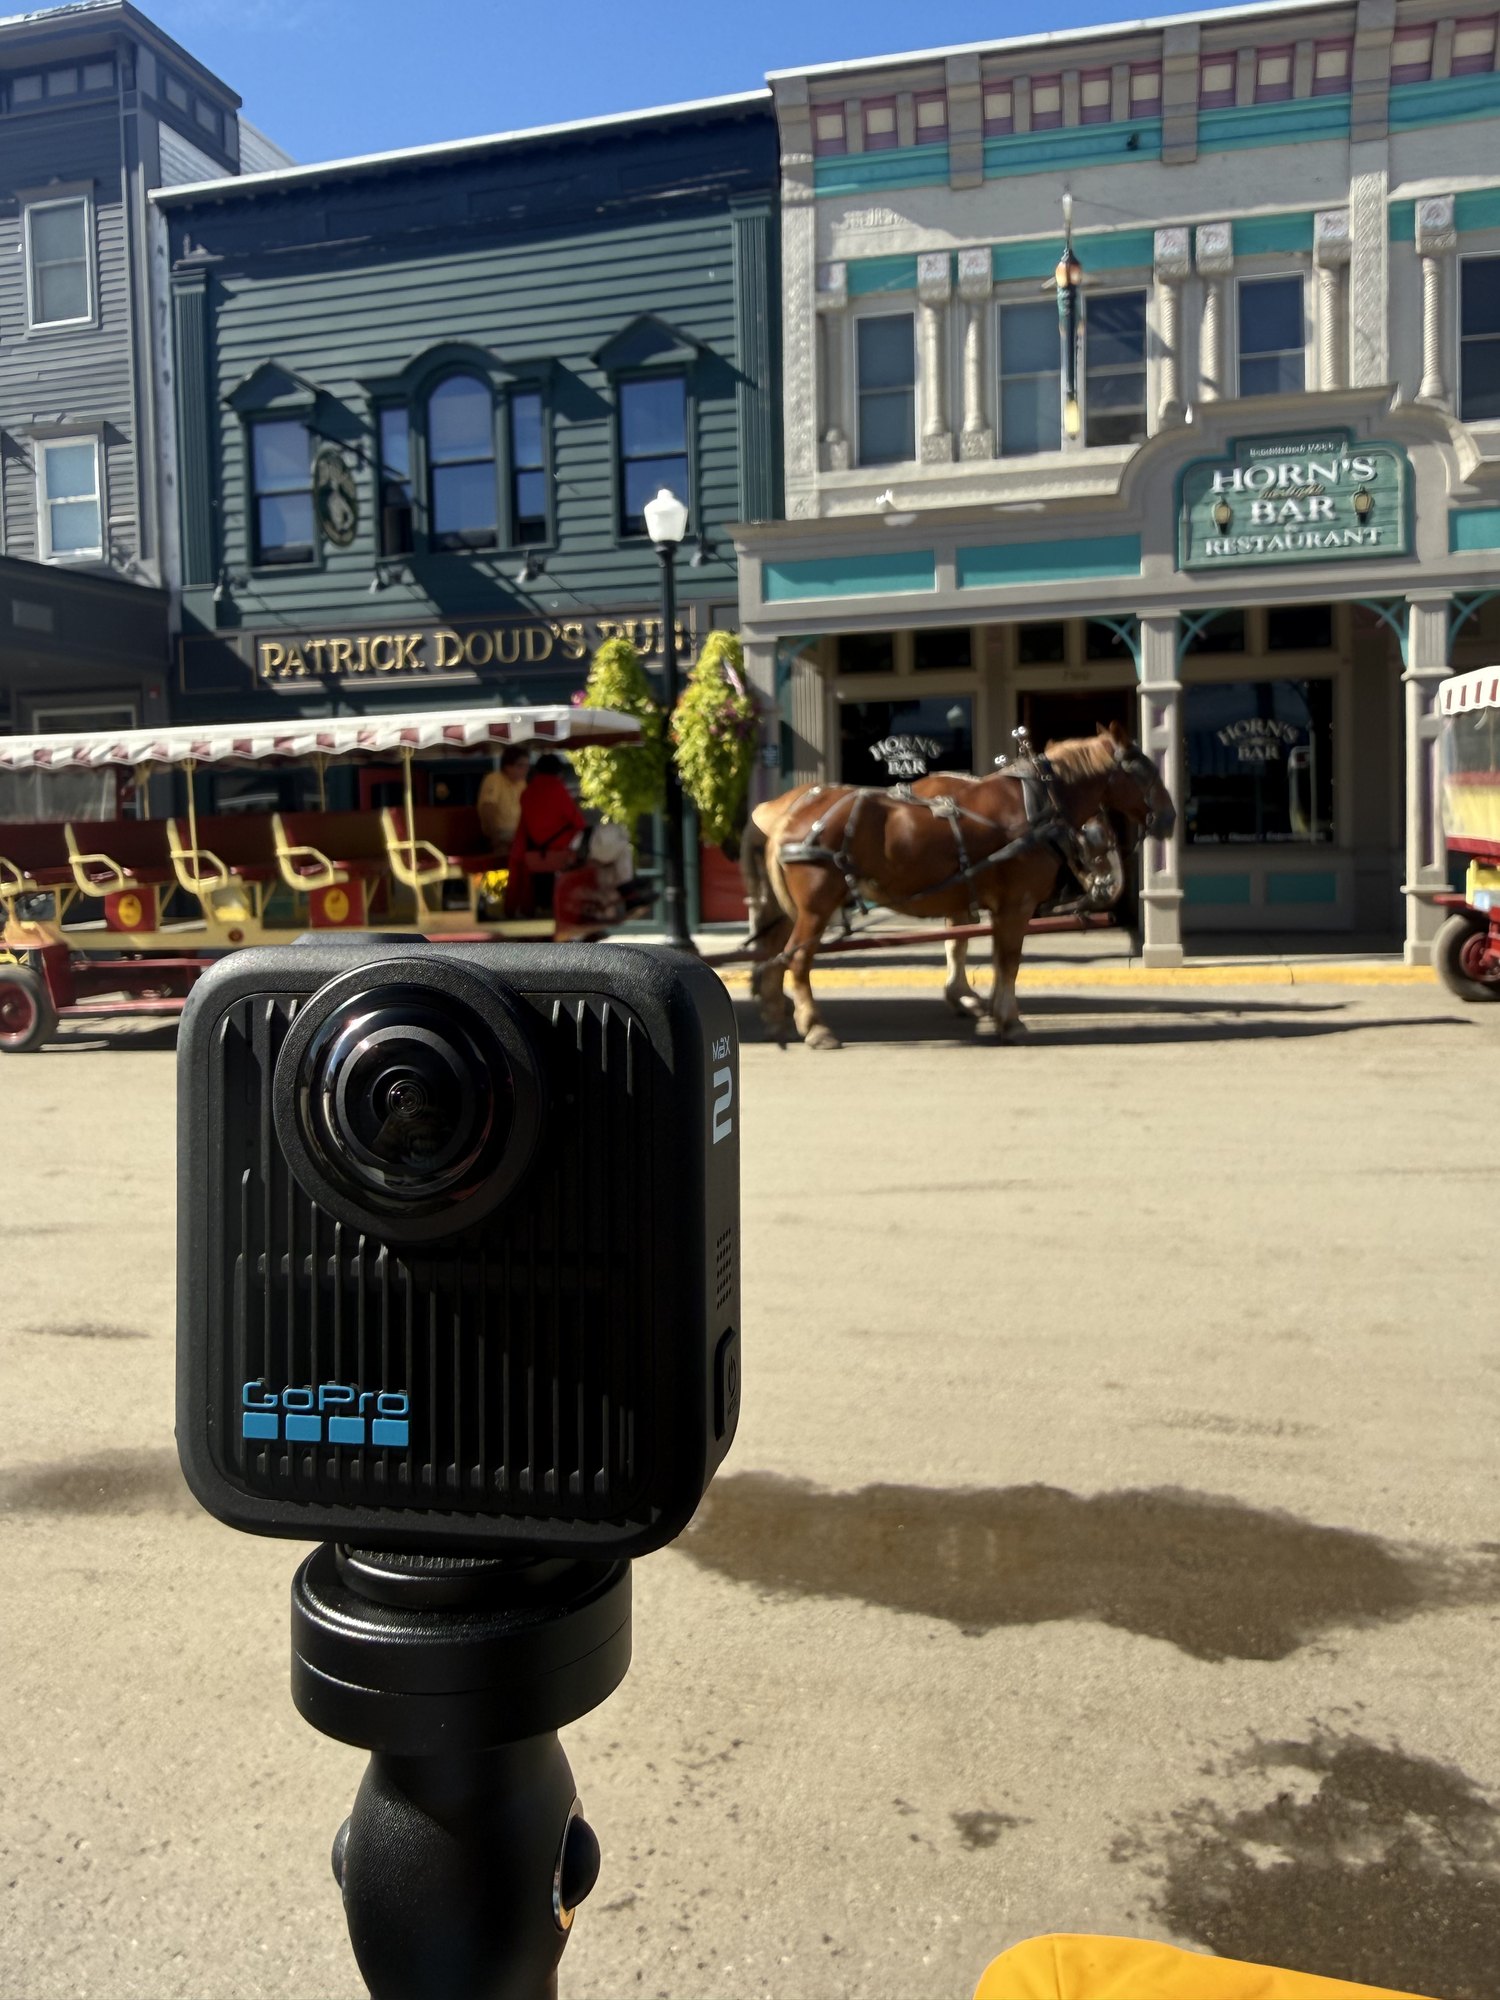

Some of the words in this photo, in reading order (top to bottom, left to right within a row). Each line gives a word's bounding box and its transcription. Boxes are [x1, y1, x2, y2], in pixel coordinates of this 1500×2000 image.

[1211, 456, 1378, 493] HORN'S
[1251, 495, 1337, 525] BAR
[1204, 526, 1383, 557] RESTAURANT
[260, 633, 425, 677] PATRICK
[433, 623, 586, 667] DOUD'S
[1216, 718, 1300, 746] HORN'S
[868, 735, 942, 762] HORN'S
[1238, 744, 1280, 761] BAR
[888, 758, 927, 775] BAR
[713, 1066, 732, 1145] 2
[243, 1381, 409, 1415] GoPro
